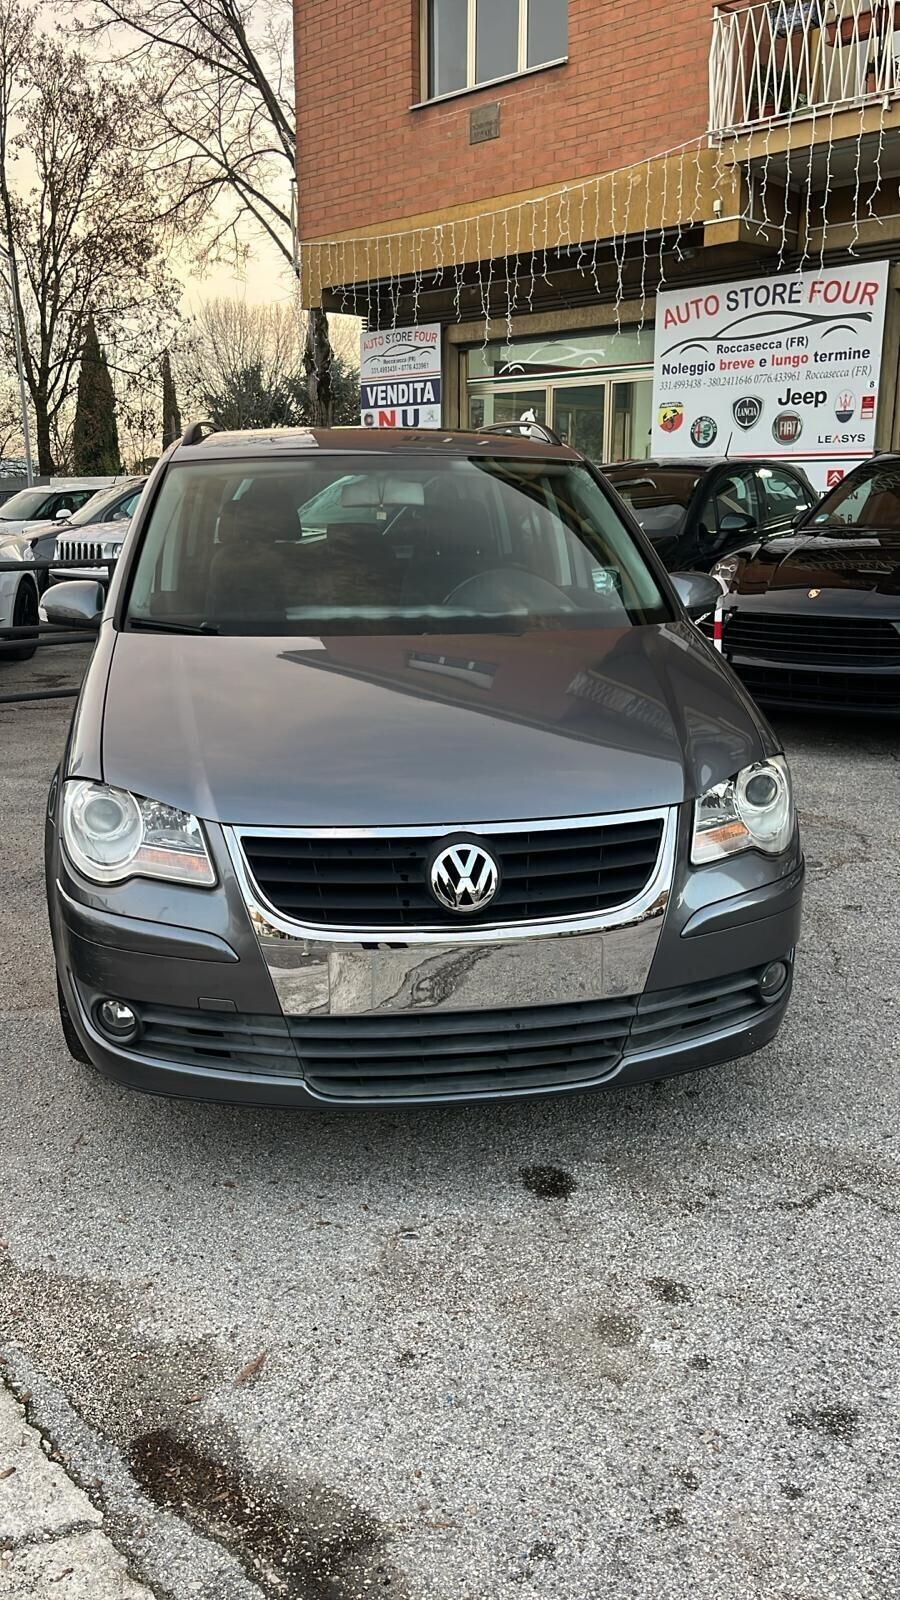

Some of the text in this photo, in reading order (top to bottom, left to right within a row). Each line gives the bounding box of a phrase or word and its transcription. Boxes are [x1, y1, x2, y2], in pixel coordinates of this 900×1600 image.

[663, 280, 879, 329] AUTO STORE FOUR
[363, 331, 438, 352] AUTO STORE FOUR
[716, 336, 809, 354] Roccasecca (FR)
[662, 347, 871, 376] Noleggio breve e lungo termine
[660, 380, 702, 391] 331.4993438
[805, 369, 850, 380] Roccasecca
[852, 365, 872, 378] (FR)
[366, 381, 435, 406] VENDITA
[777, 388, 827, 408] Jeep
[738, 407, 758, 417] LANCIA
[780, 420, 798, 435] FIAT
[817, 433, 866, 444] LEASYS
